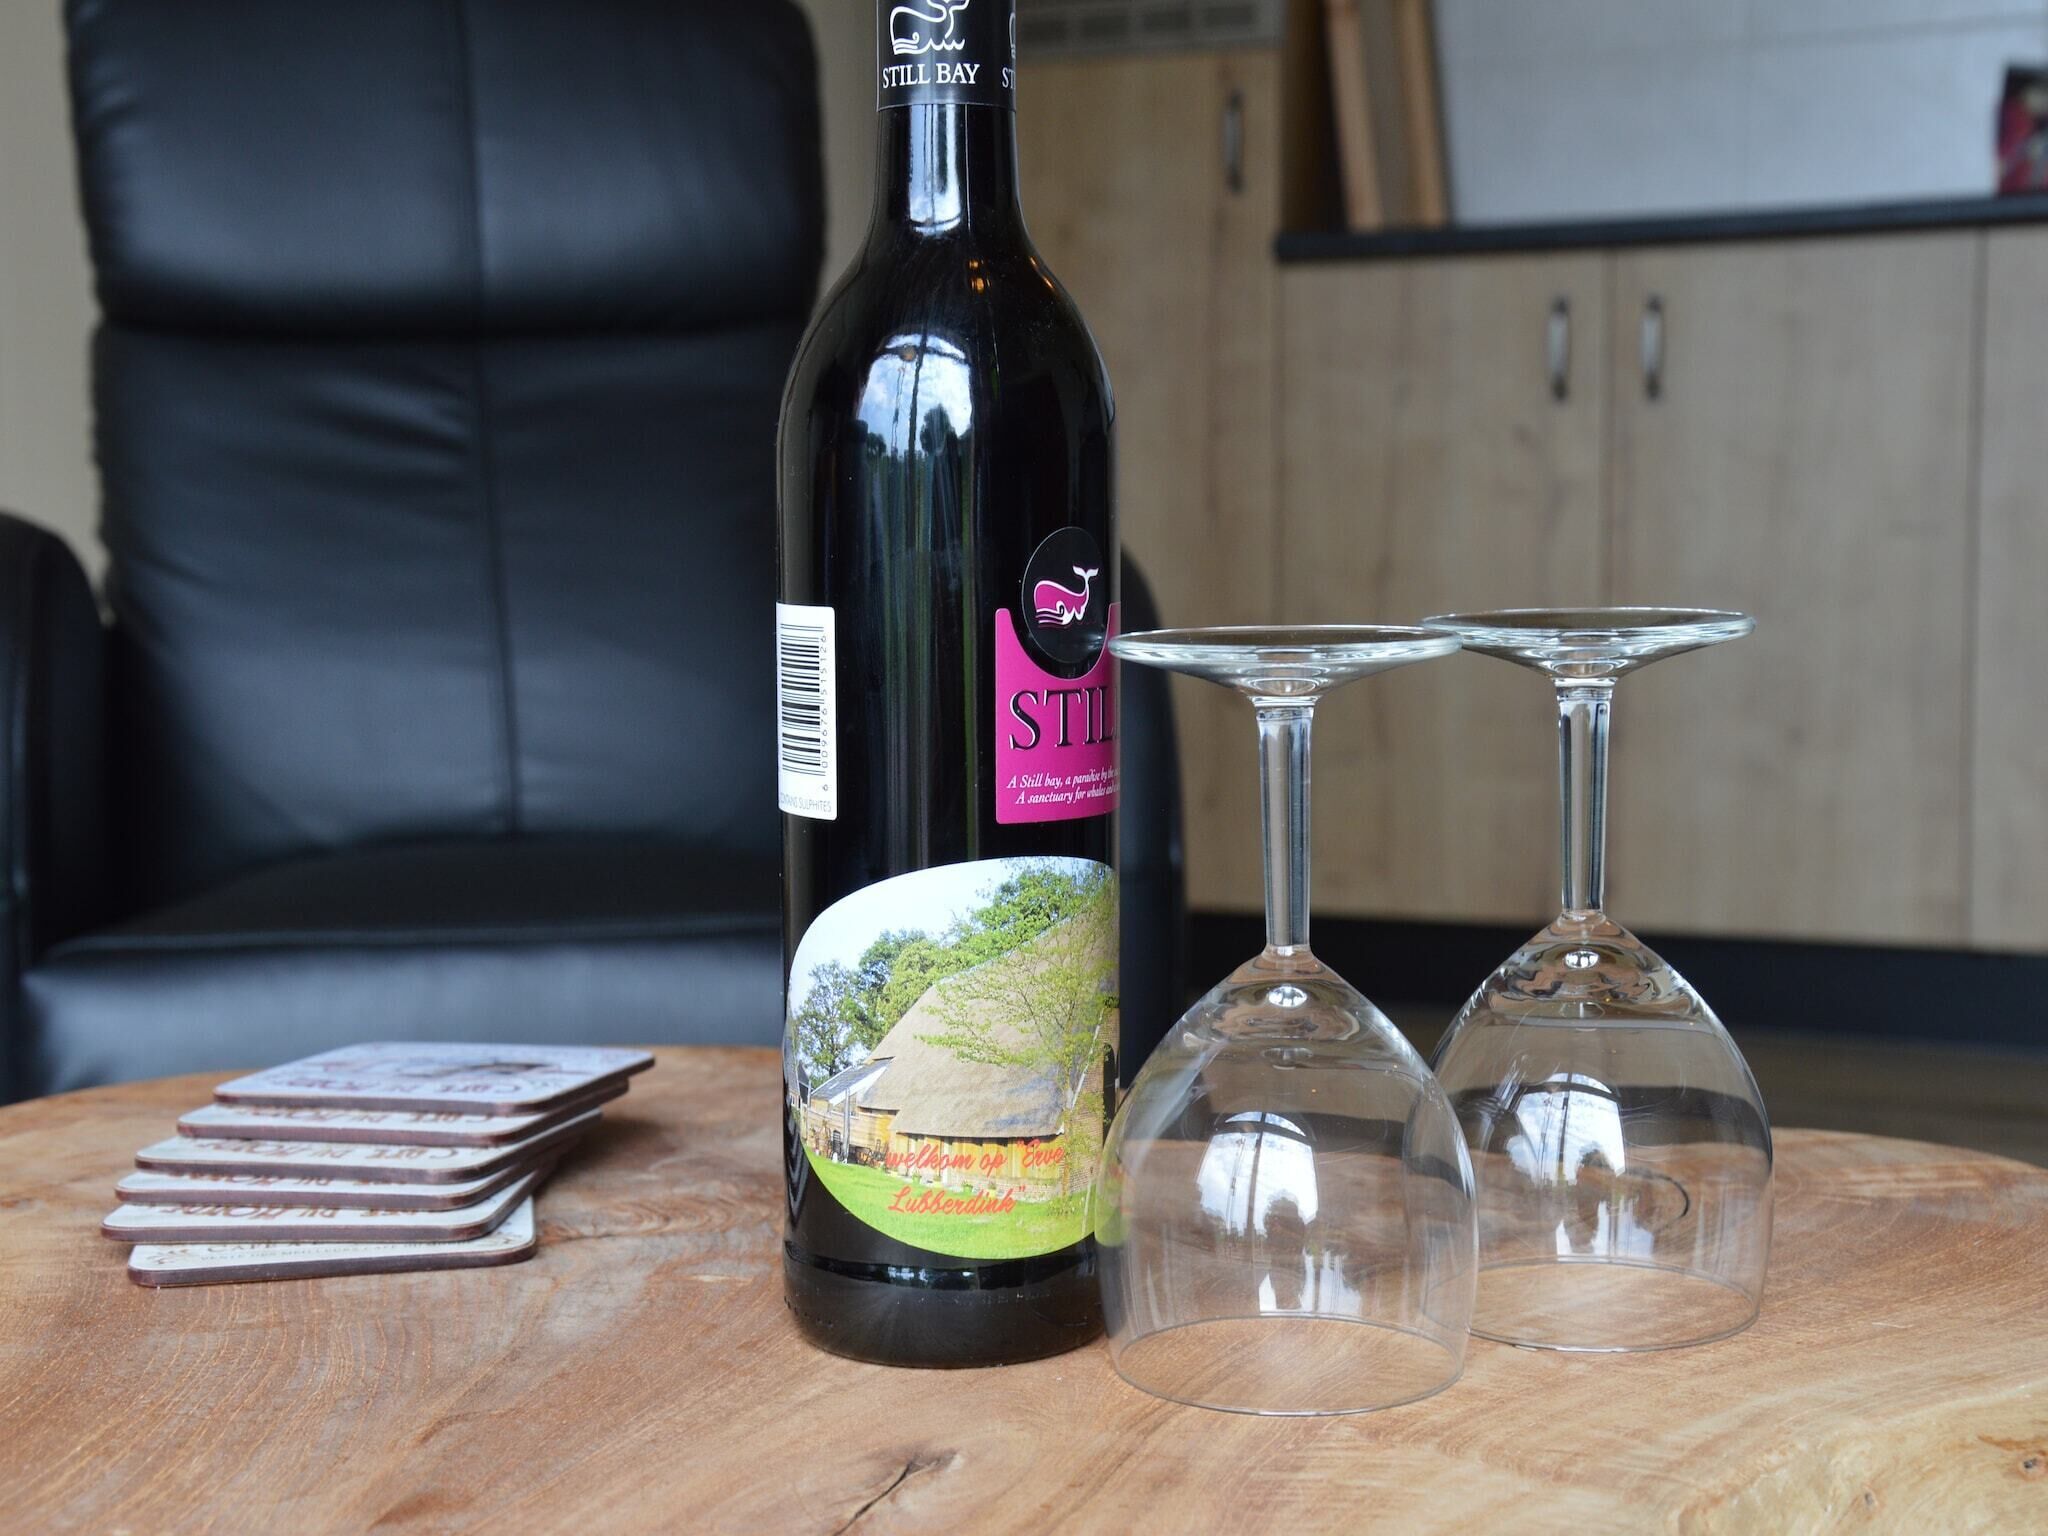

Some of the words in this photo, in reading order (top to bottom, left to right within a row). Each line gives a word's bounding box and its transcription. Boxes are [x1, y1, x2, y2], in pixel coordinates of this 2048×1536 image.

[882, 63, 931, 89] STILL
[935, 62, 980, 85] BAY
[1008, 686, 1119, 751] STIL
[822, 784, 829, 792] 6
[1006, 775, 1017, 789] A
[1020, 772, 1043, 788] Still
[1044, 773, 1063, 790] bay,
[1015, 790, 1025, 805] A
[1027, 791, 1073, 805] sanctuary
[1073, 786, 1086, 804] for
[885, 1143, 976, 1170] welkom
[978, 1151, 1007, 1179] op
